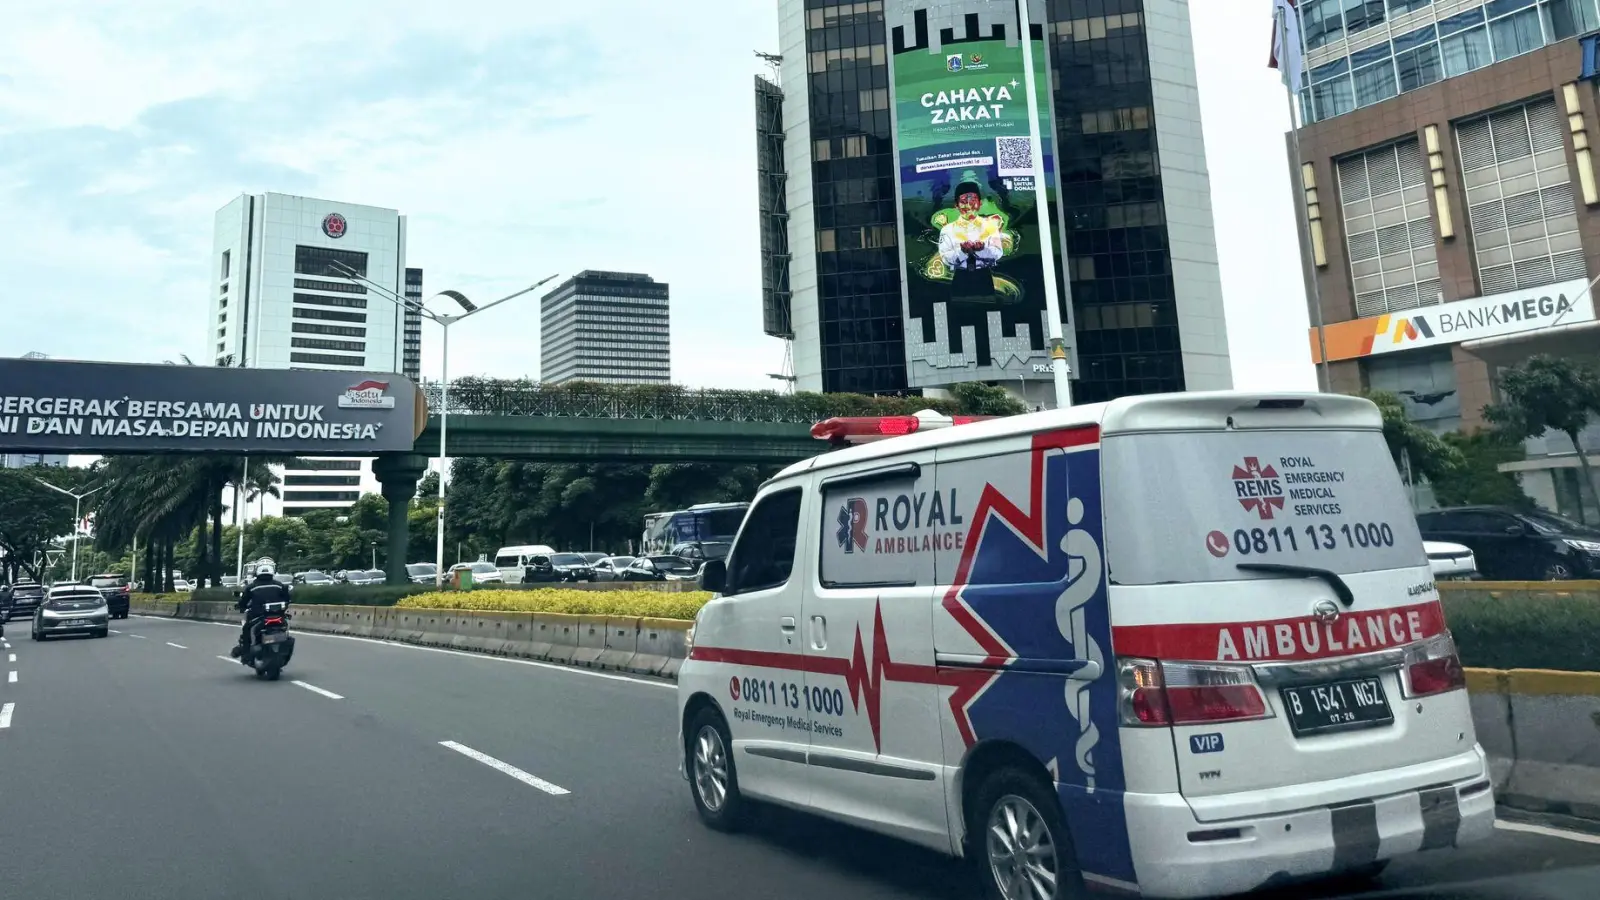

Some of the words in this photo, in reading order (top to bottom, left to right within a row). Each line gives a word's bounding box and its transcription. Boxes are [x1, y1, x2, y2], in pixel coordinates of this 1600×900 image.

[921, 87, 1012, 107] CAHAYA
[931, 104, 1003, 124] ZAKAT
[0, 396, 120, 417] ERGERAK
[127, 401, 241, 419] BERSAMA
[249, 404, 324, 421] UNTUK
[26, 417, 84, 435] DAN
[90, 418, 167, 436] MASA
[173, 420, 250, 438] DEPAN
[256, 422, 378, 440] INDONESIA
[1280, 456, 1315, 468] ROYAL
[1234, 478, 1283, 498] REMS
[1284, 471, 1345, 484] EMERGENCY
[1289, 487, 1336, 500] MEDICAL
[875, 487, 963, 532] ROYAL
[1294, 503, 1342, 516] SERVICES
[874, 531, 964, 555] AMBULANCE
[1233, 525, 1298, 555] 0811
[1305, 523, 1336, 550] 13
[1340, 522, 1394, 548] 1000
[1217, 611, 1423, 660] AMBULANCE
[742, 677, 776, 705] 0811
[781, 682, 799, 709] 13
[803, 685, 844, 717] 1000
[1292, 691, 1303, 716] B
[1310, 686, 1347, 713] 1541
[1353, 681, 1384, 708] NGZ
[734, 708, 750, 722] Royal
[751, 710, 786, 730] Emergency
[787, 715, 813, 732] Medical
[813, 720, 843, 737] Services
[1329, 711, 1356, 723] 07-26
[1194, 735, 1220, 751] VIP
